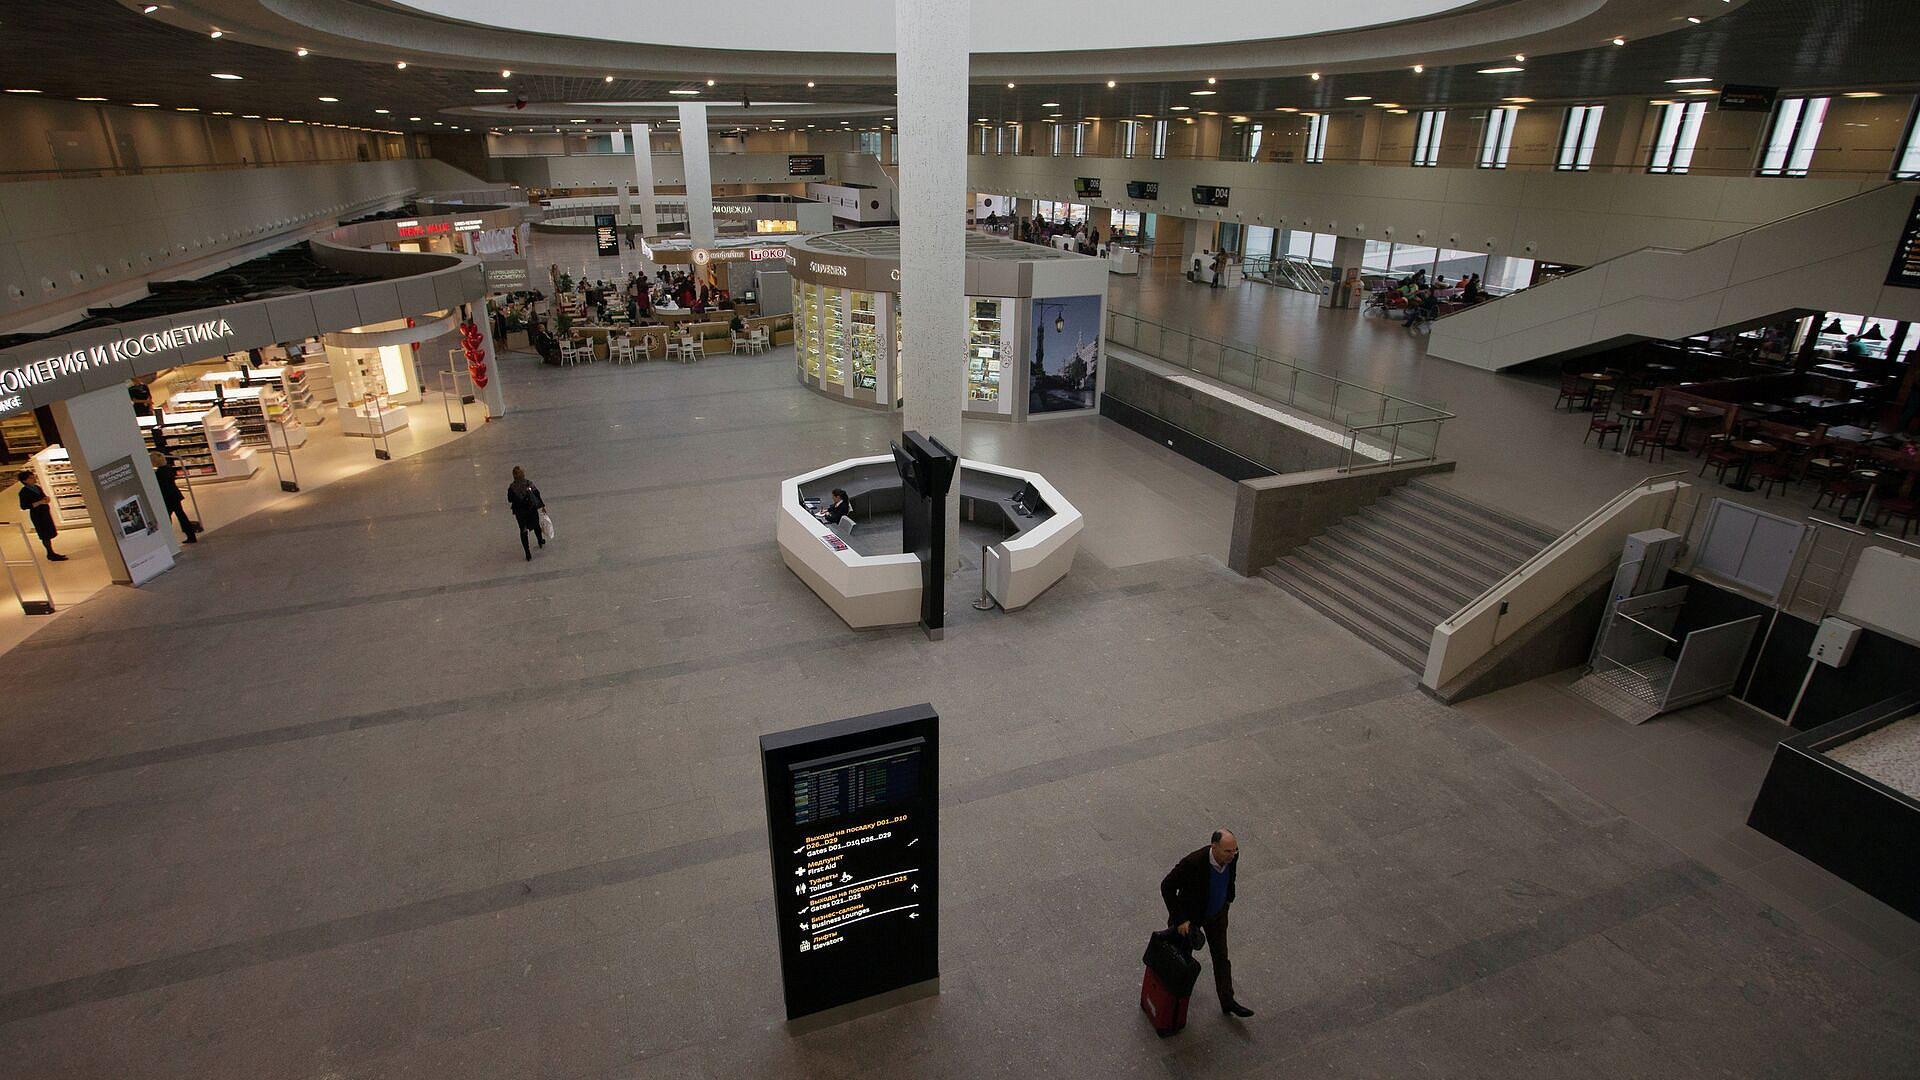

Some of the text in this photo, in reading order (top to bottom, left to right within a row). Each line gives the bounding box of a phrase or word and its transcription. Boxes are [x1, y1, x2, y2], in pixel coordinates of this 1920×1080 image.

[1146, 184, 1158, 192] D05
[1216, 188, 1228, 198] D04
[750, 249, 786, 261] ШОКО
[91, 346, 110, 366] И
[110, 319, 234, 362] КОСМЕТИКА
[806, 832, 834, 843] Выходы
[846, 822, 876, 834] посадку
[806, 848, 828, 857] Gates
[808, 854, 844, 868] Медпункт
[808, 862, 836, 876] First Aid
[809, 873, 838, 886] Туалеты
[809, 882, 832, 892] Toilets
[810, 894, 838, 906] Выходы
[848, 883, 876, 895] посадку
[810, 902, 830, 912] Gates
[811, 904, 864, 923] Бизнес-салоны
[812, 908, 870, 930] Business Lounges
[812, 936, 844, 950] Elevators
[814, 931, 838, 944] Лифты
